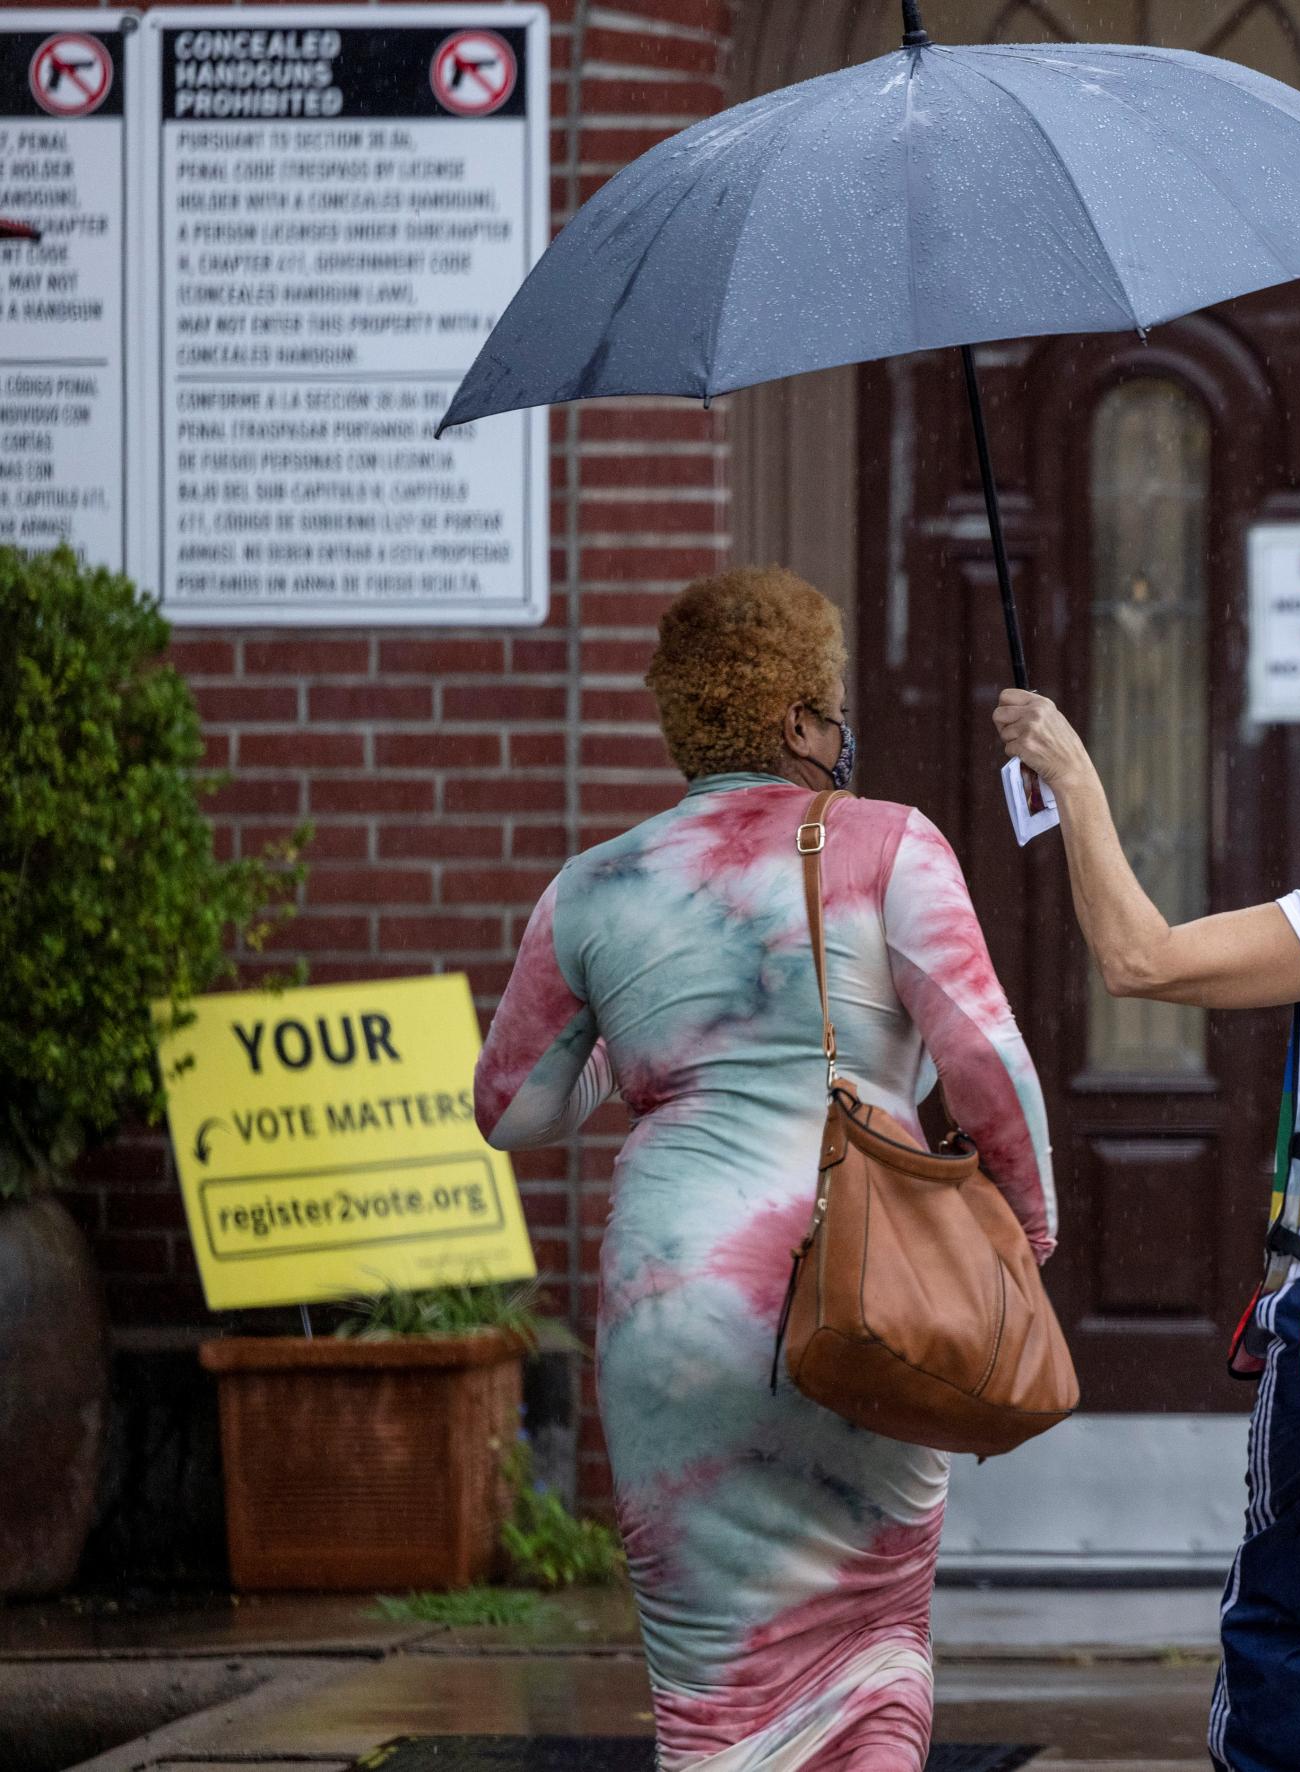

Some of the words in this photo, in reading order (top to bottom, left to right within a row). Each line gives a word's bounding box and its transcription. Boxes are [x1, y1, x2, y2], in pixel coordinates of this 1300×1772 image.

[174, 30, 341, 61] CONCEALED
[174, 61, 333, 88] HANDGUNS
[174, 88, 343, 117] PROHIBITED
[231, 1010, 402, 1075] YOUR
[231, 1104, 316, 1145] VOTE
[327, 1089, 474, 1134] MATTERS
[217, 1180, 488, 1237] register2vote.org
